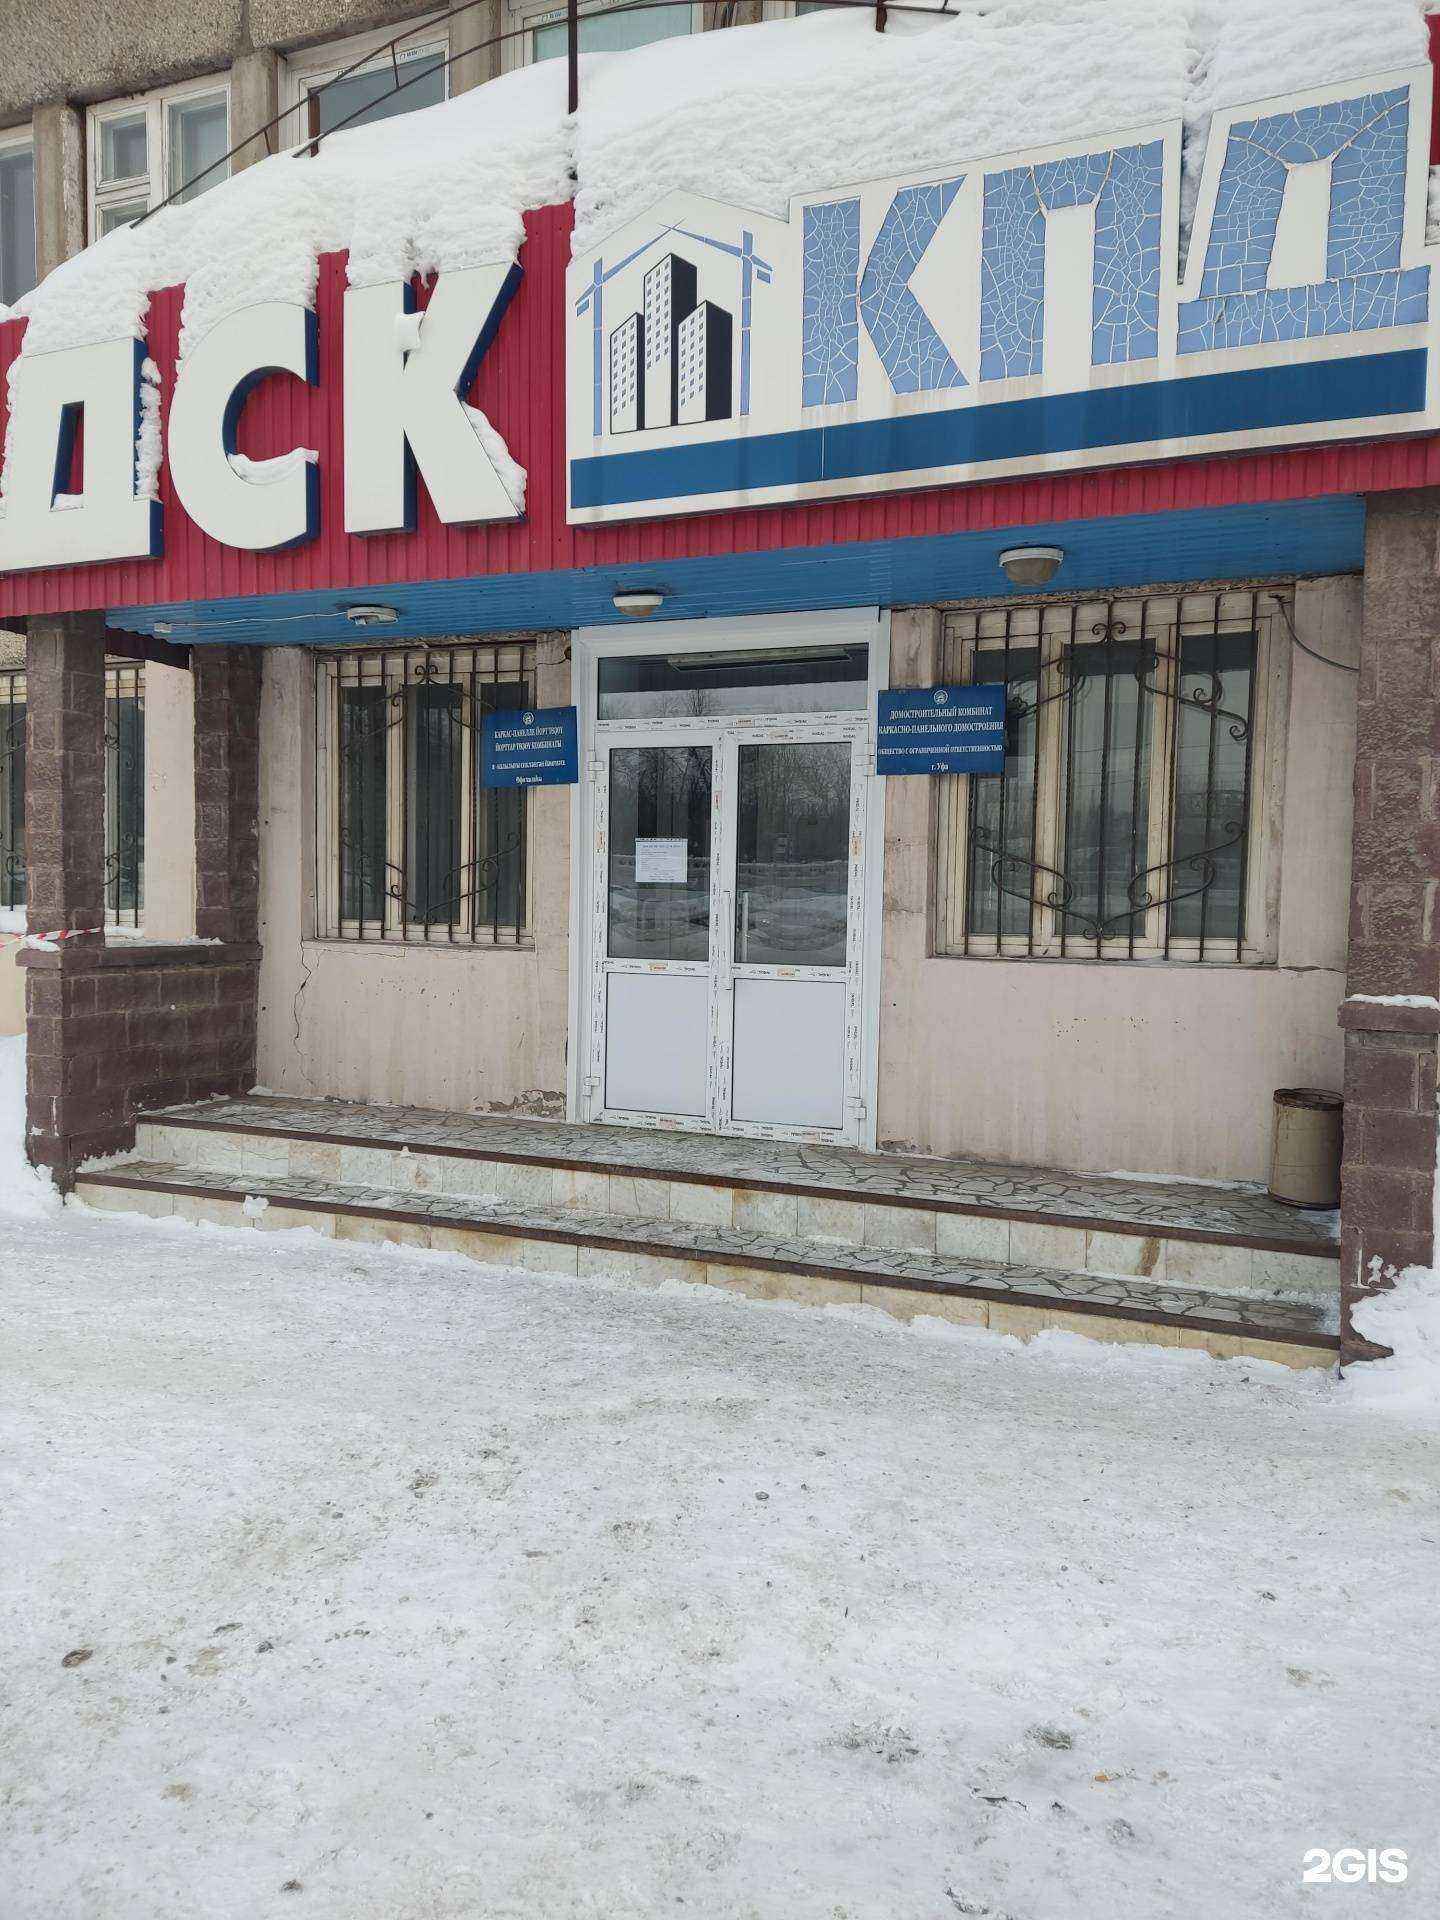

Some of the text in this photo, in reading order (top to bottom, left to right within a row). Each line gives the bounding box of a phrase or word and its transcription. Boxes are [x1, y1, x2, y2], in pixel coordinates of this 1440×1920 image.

[0, 84, 1430, 572] ДСК КПД
[890, 706, 993, 720] ДОМОСТРОИТЕЛЬНЫЙ КОМБИНАТ
[879, 723, 953, 734] КАРКАСНО-ПАНЕЛЬНОГО
[954, 721, 1004, 732] ДОМОСТРОЕНИЯ
[937, 763, 949, 773] Уфа
